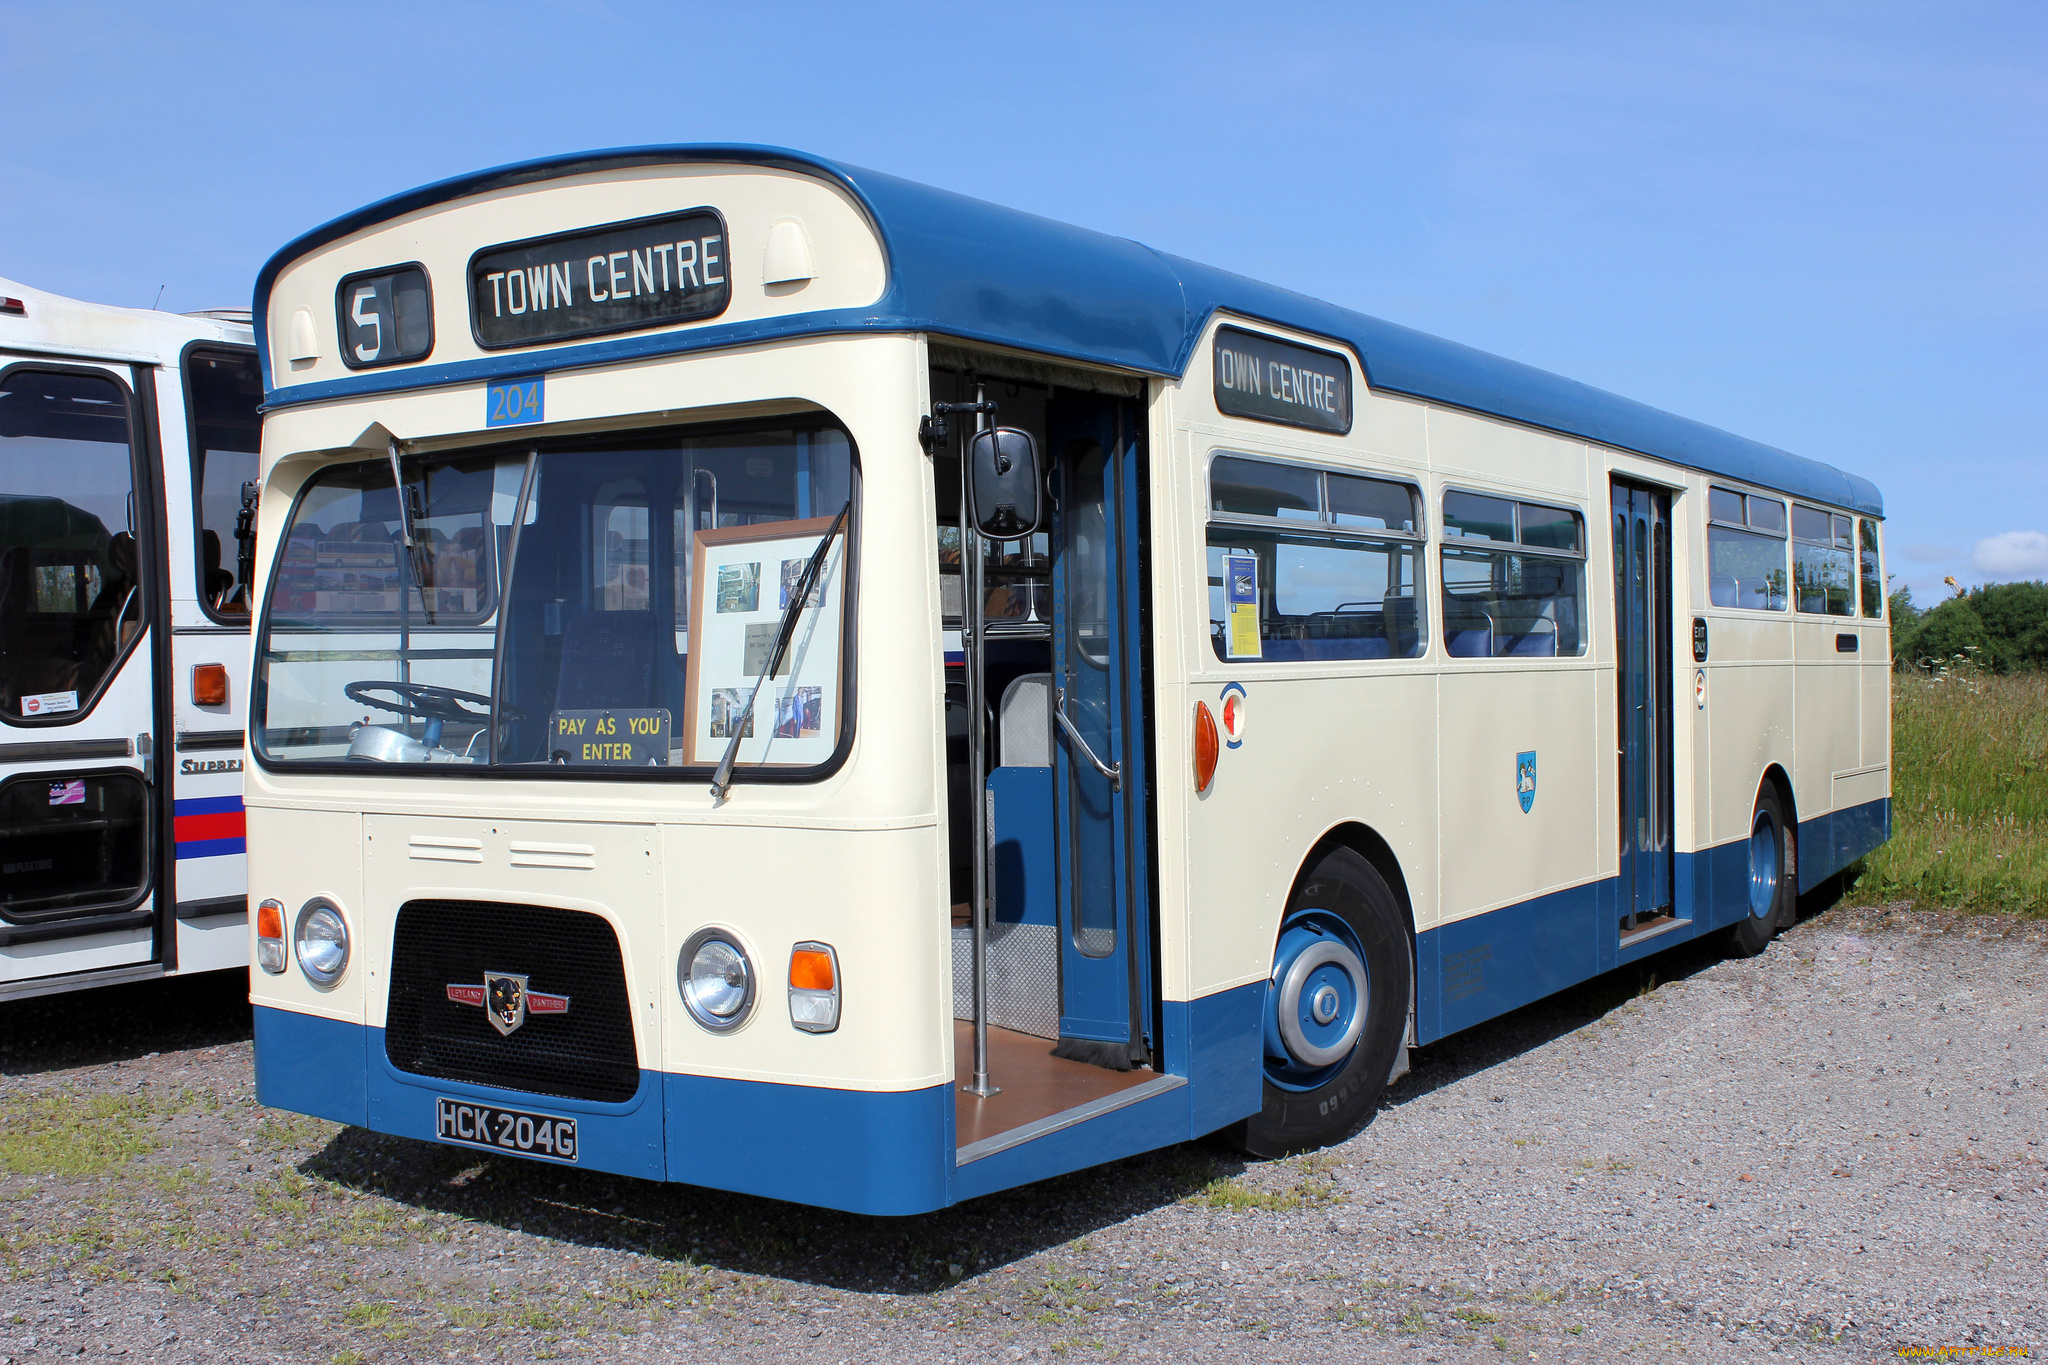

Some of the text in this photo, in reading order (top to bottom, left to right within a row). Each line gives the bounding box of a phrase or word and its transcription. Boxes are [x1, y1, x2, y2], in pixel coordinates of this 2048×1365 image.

[487, 235, 725, 317] TOWN CENTRE
[351, 285, 380, 361] 5
[492, 383, 539, 420] 204
[1216, 347, 1335, 413] OWN CENTRE
[1056, 624, 1064, 674] OPEN
[559, 717, 660, 735] PAY AS YOU
[582, 743, 632, 760] ENTER
[451, 988, 564, 1010] LEYLAND PANTHER
[440, 1102, 574, 1156] HCK 204G
